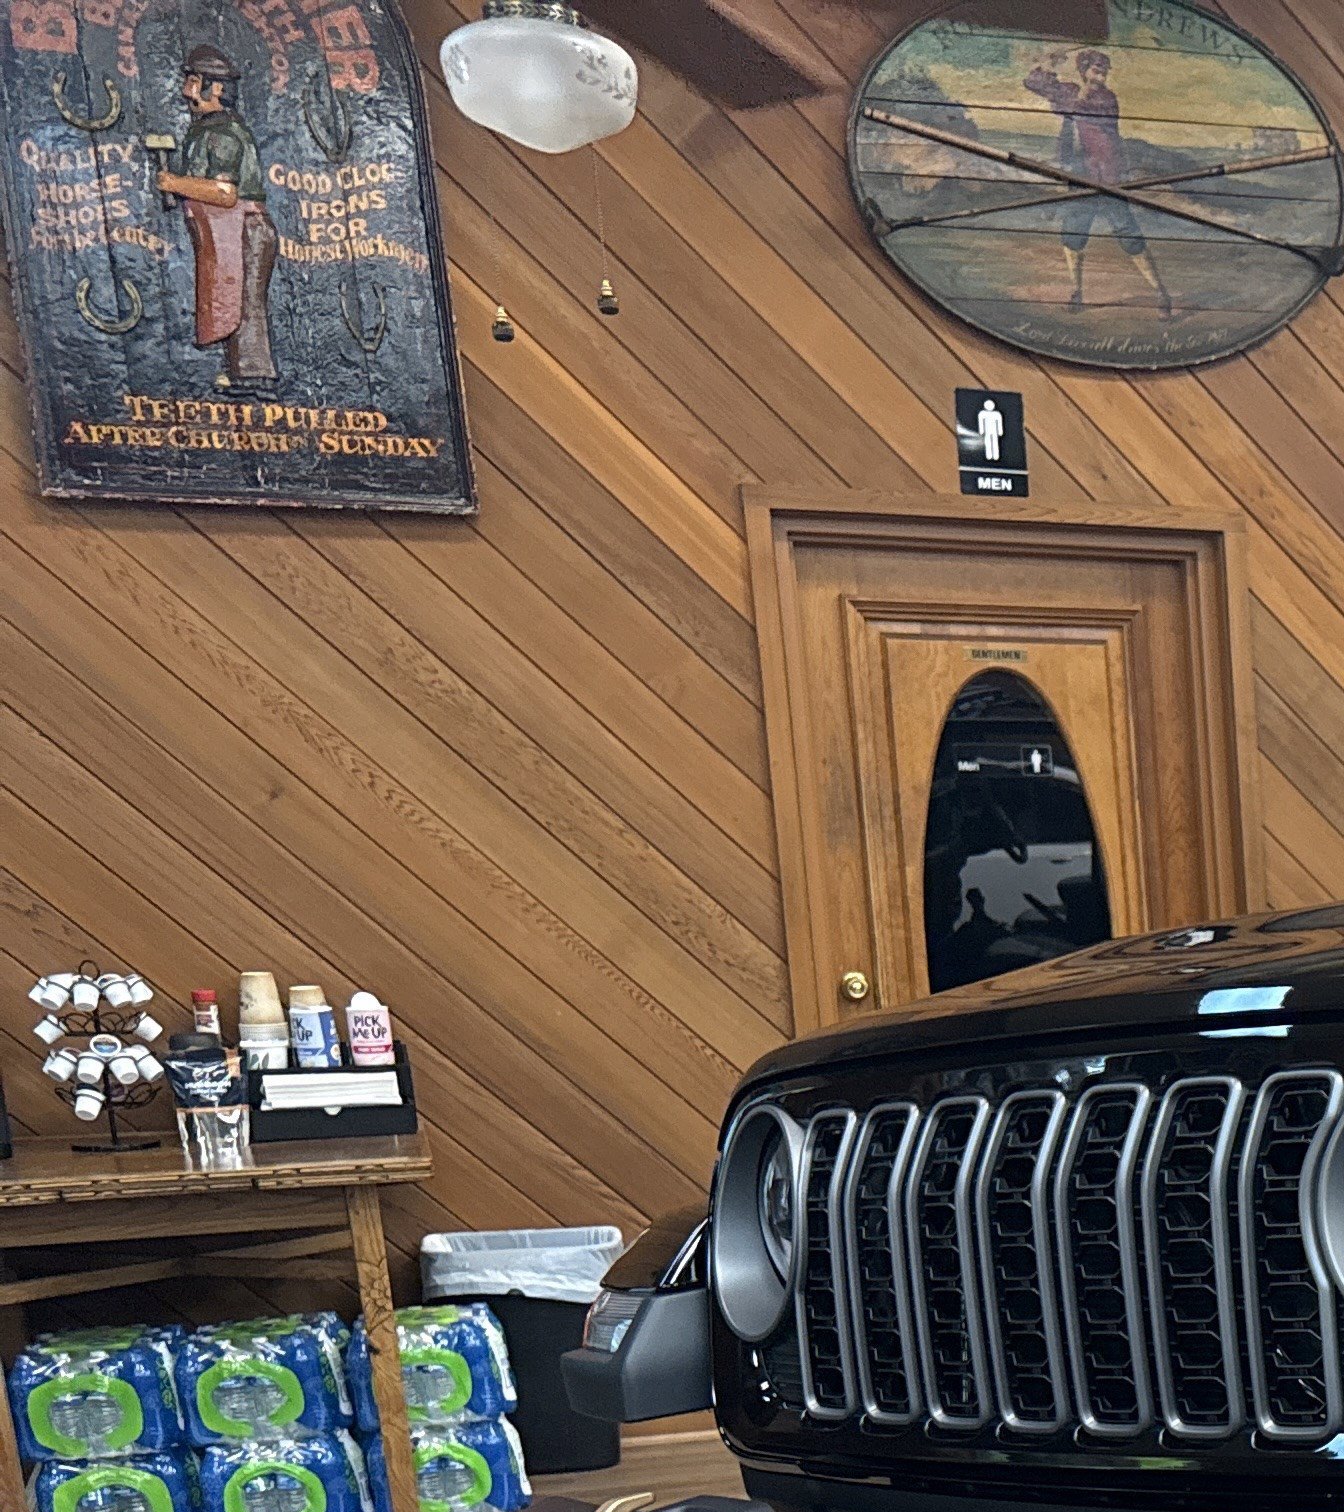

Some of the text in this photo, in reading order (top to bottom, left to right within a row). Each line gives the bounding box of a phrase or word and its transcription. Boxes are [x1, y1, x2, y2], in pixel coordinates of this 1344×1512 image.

[20, 139, 134, 172] QUALITY
[268, 163, 333, 194] GOOD
[301, 190, 387, 219] IRONS
[308, 218, 368, 242] FOR
[123, 395, 388, 432] TEETH PULLED
[63, 421, 163, 447] AFTER
[168, 425, 290, 453] CHURCH
[319, 432, 445, 458] SUNDAY
[977, 477, 1013, 491] MEN
[353, 1015, 381, 1028] PICK
[371, 1027, 388, 1039] UP
